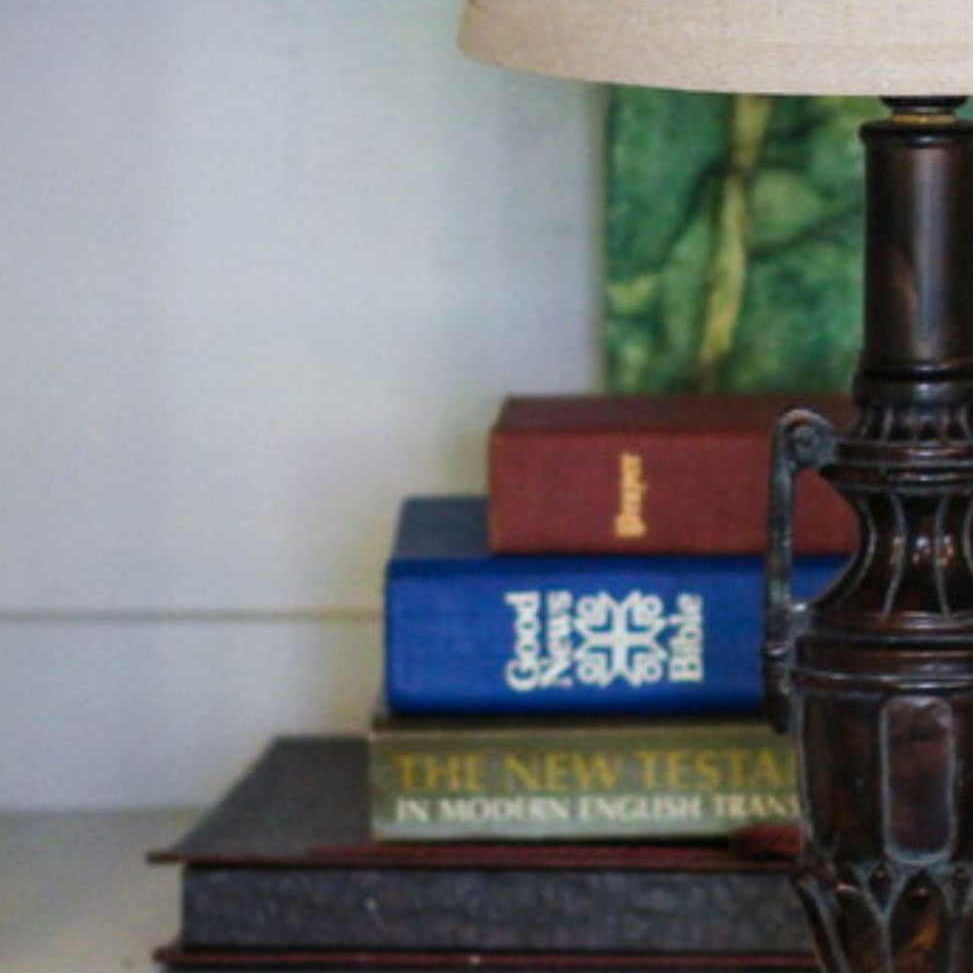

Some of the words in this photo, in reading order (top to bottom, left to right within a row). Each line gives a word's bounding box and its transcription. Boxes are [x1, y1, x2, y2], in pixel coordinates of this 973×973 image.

[505, 590, 541, 691] Good
[537, 590, 574, 688] News
[667, 593, 704, 683] Bible
[395, 796, 430, 822] IN
[440, 795, 571, 822] MODERN
[578, 794, 701, 821] ENGLISH
[396, 754, 486, 792] THE
[504, 752, 621, 791] NEW
